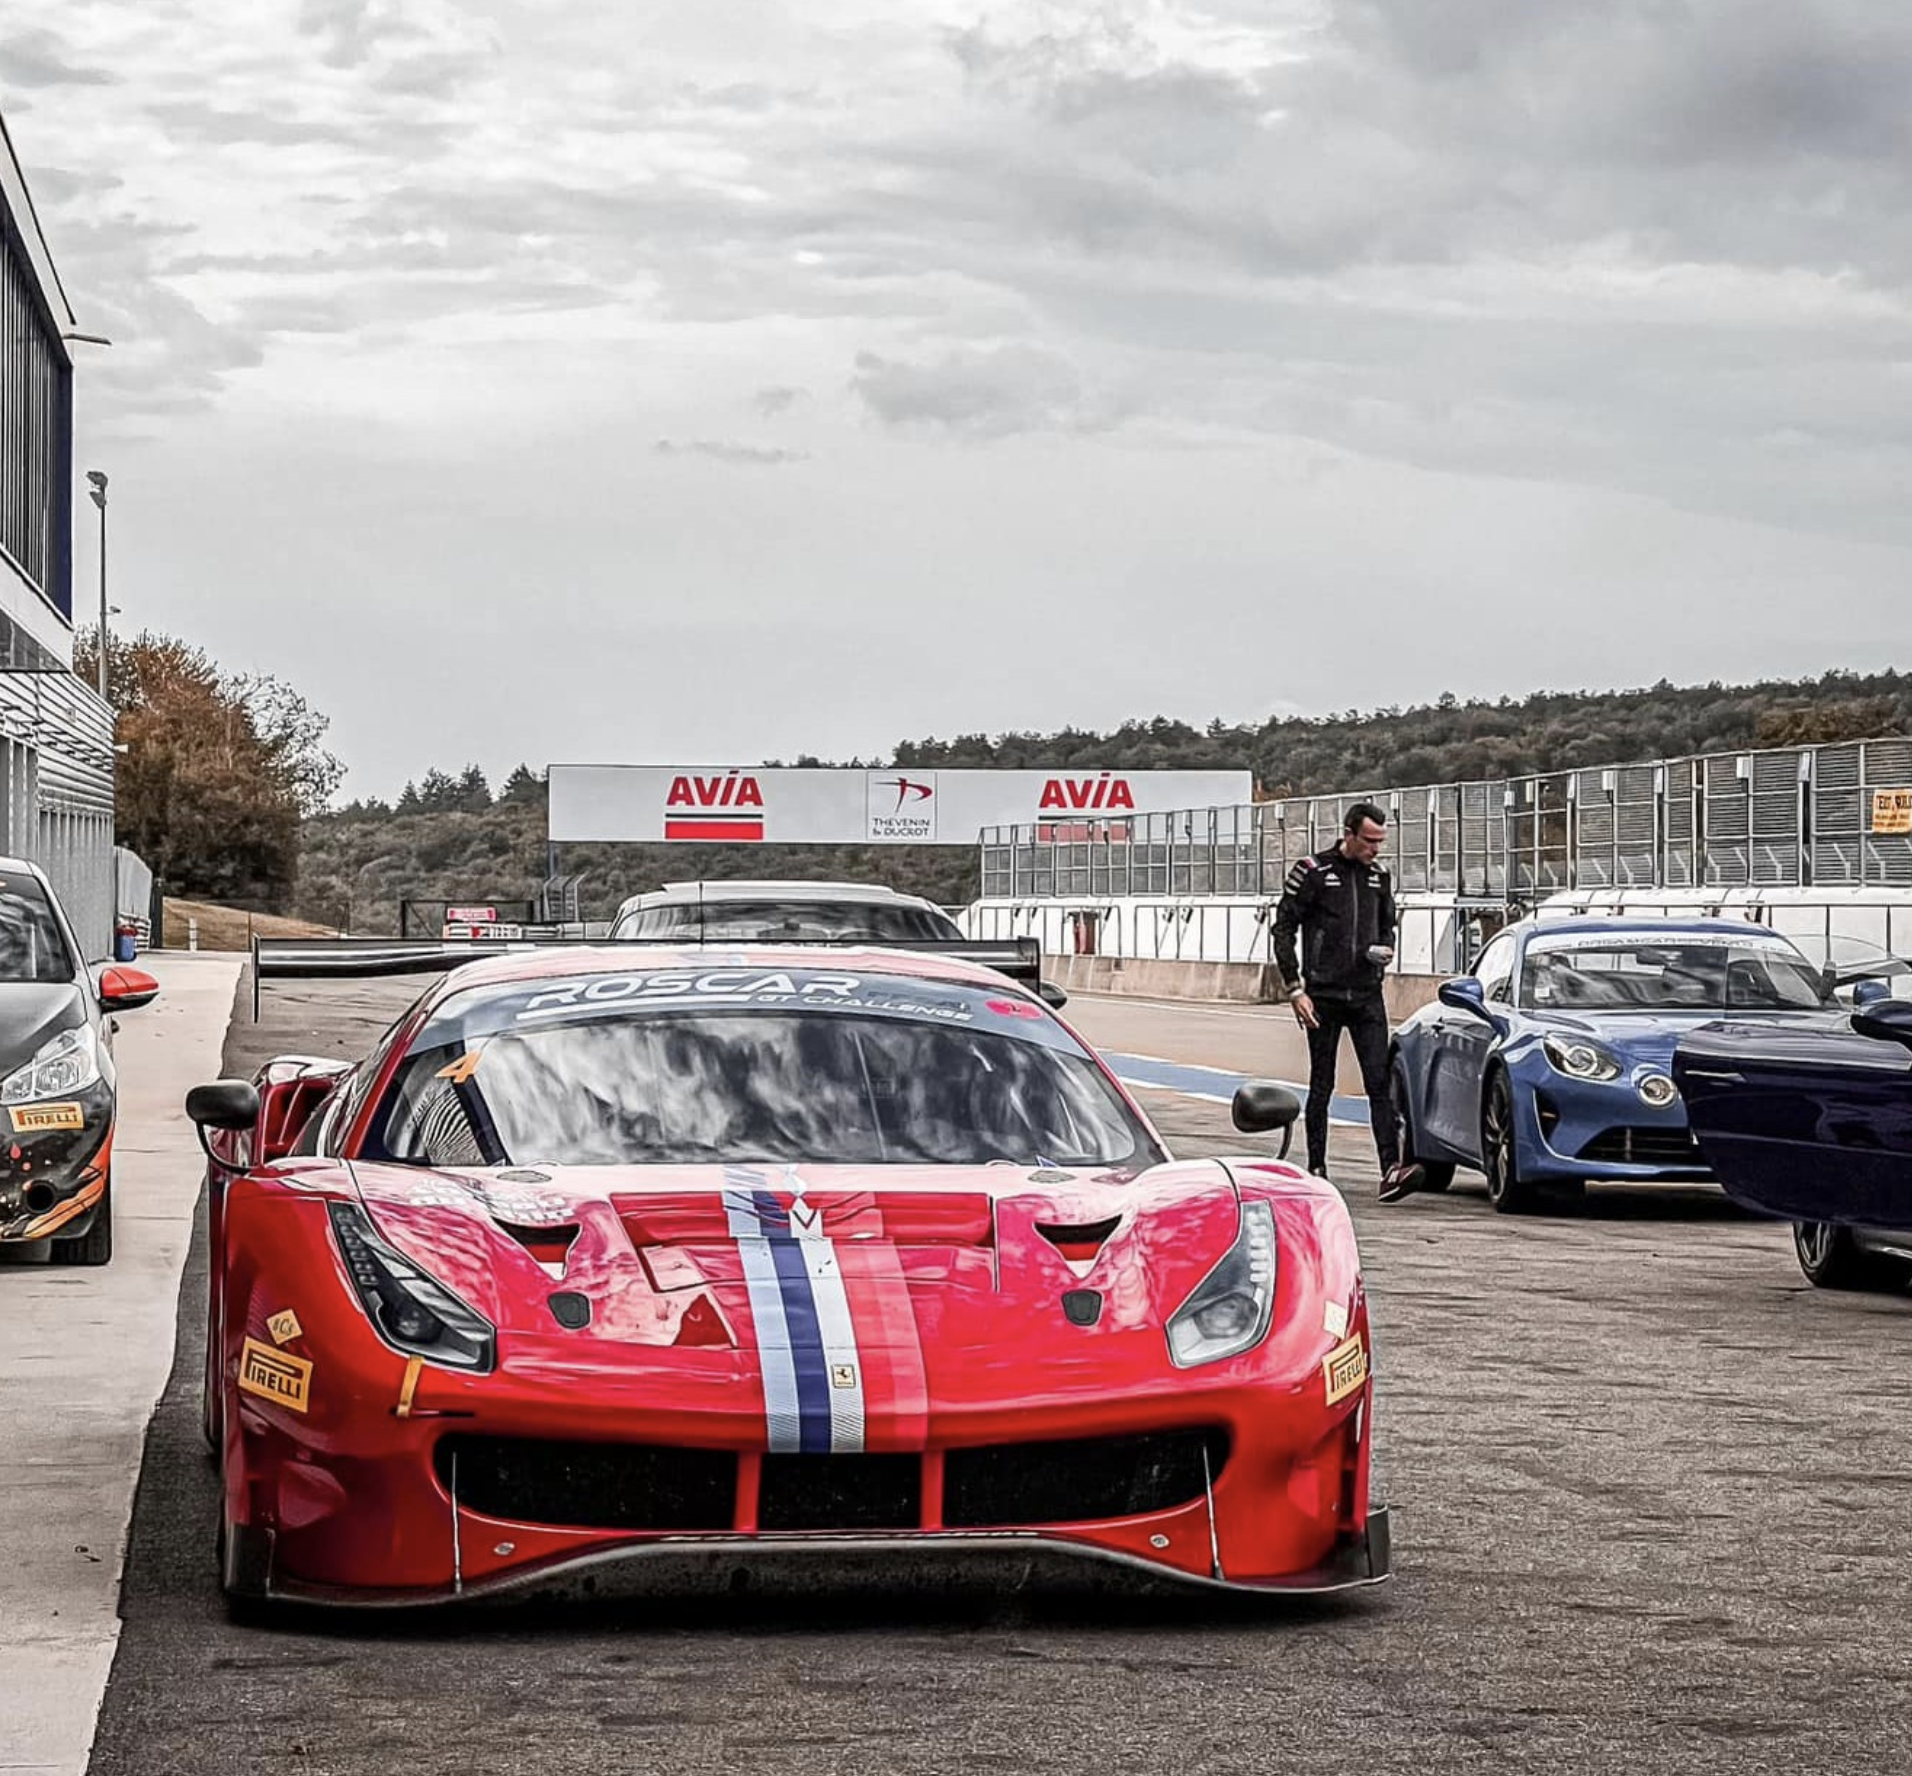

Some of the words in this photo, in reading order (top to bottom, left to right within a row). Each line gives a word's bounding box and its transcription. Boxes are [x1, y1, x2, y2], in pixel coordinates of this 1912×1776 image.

[525, 973, 861, 1009] ROSCAR
[803, 995, 974, 1022] CHALLENGE
[16, 1106, 78, 1126] PIRELLI
[244, 1347, 304, 1400] PIRELLI
[1329, 1343, 1363, 1393] PIRELLI
